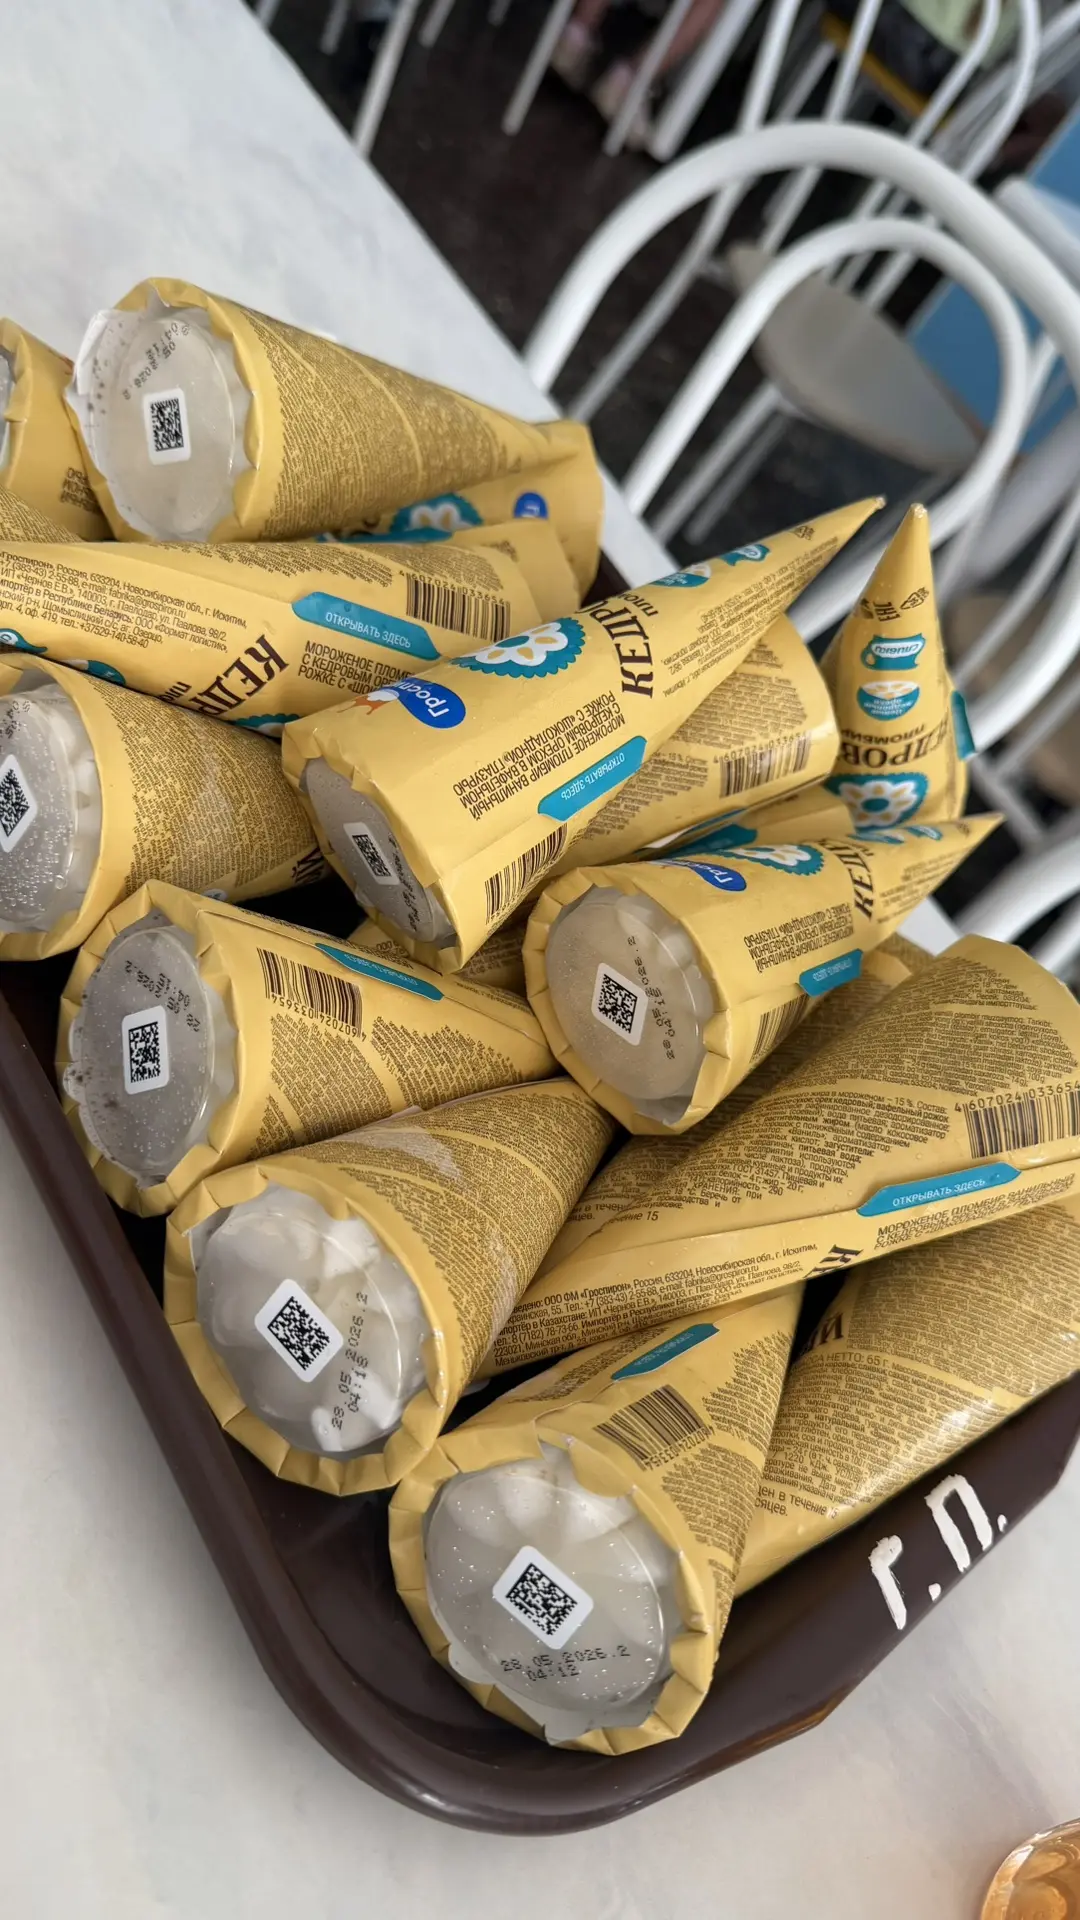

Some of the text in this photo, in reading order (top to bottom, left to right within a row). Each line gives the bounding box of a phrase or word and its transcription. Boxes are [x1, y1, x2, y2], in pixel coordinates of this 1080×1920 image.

[11, 559, 48, 578] (383-43)
[47, 570, 81, 587] 2-55-88,
[56, 564, 89, 580] Россия,
[121, 583, 185, 609] Новосибирская
[41, 590, 93, 612] Республике
[92, 605, 134, 624] Беларусь:
[134, 617, 154, 629] ООО
[326, 612, 411, 648] ОТКРЫВАТЬ ЗДЕСЬ
[302, 655, 372, 684] С КЕДРОВЫМ
[305, 641, 373, 672] МОРОЖЕНОЕ
[298, 665, 346, 689] РОЖКЕ С
[614, 702, 620, 714] С
[566, 707, 613, 744] КЕДРОВЫМ
[453, 690, 615, 796] РОЖКЕ С «ШОКОЛАДНОЙ» ГЛАЗУРЬЮ
[528, 736, 565, 767] ОРЕХОМ
[469, 713, 625, 821] МОРОЖЕНОЕ ПЛОМБИР ВАНИЛЬНЫЙ
[561, 752, 625, 800] ОТКРЫВАТЬ ЗДЕСЬ
[460, 766, 521, 809] ВАФЕЛЬНОМ
[893, 1179, 985, 1206] ОТКРЫВАТЬ ЗДЕСЬ
[647, 1211, 659, 1221] 15
[877, 1210, 949, 1235] МОРОЖЕНОЕ
[951, 1193, 1006, 1216] ПЛОМБИР
[544, 1294, 562, 1306] ООО
[564, 1291, 579, 1303] ФМ
[634, 1276, 663, 1290] Россия,
[696, 1256, 755, 1277] Новосибирская
[597, 1292, 628, 1308] (383-43)
[539, 1312, 587, 1328] Казахстане:
[827, 1352, 864, 1363] НЕТТО:
[867, 1355, 880, 1365] 65
[779, 1491, 827, 1515] в течение
[501, 1644, 631, 1672] 28.05.2026.2
